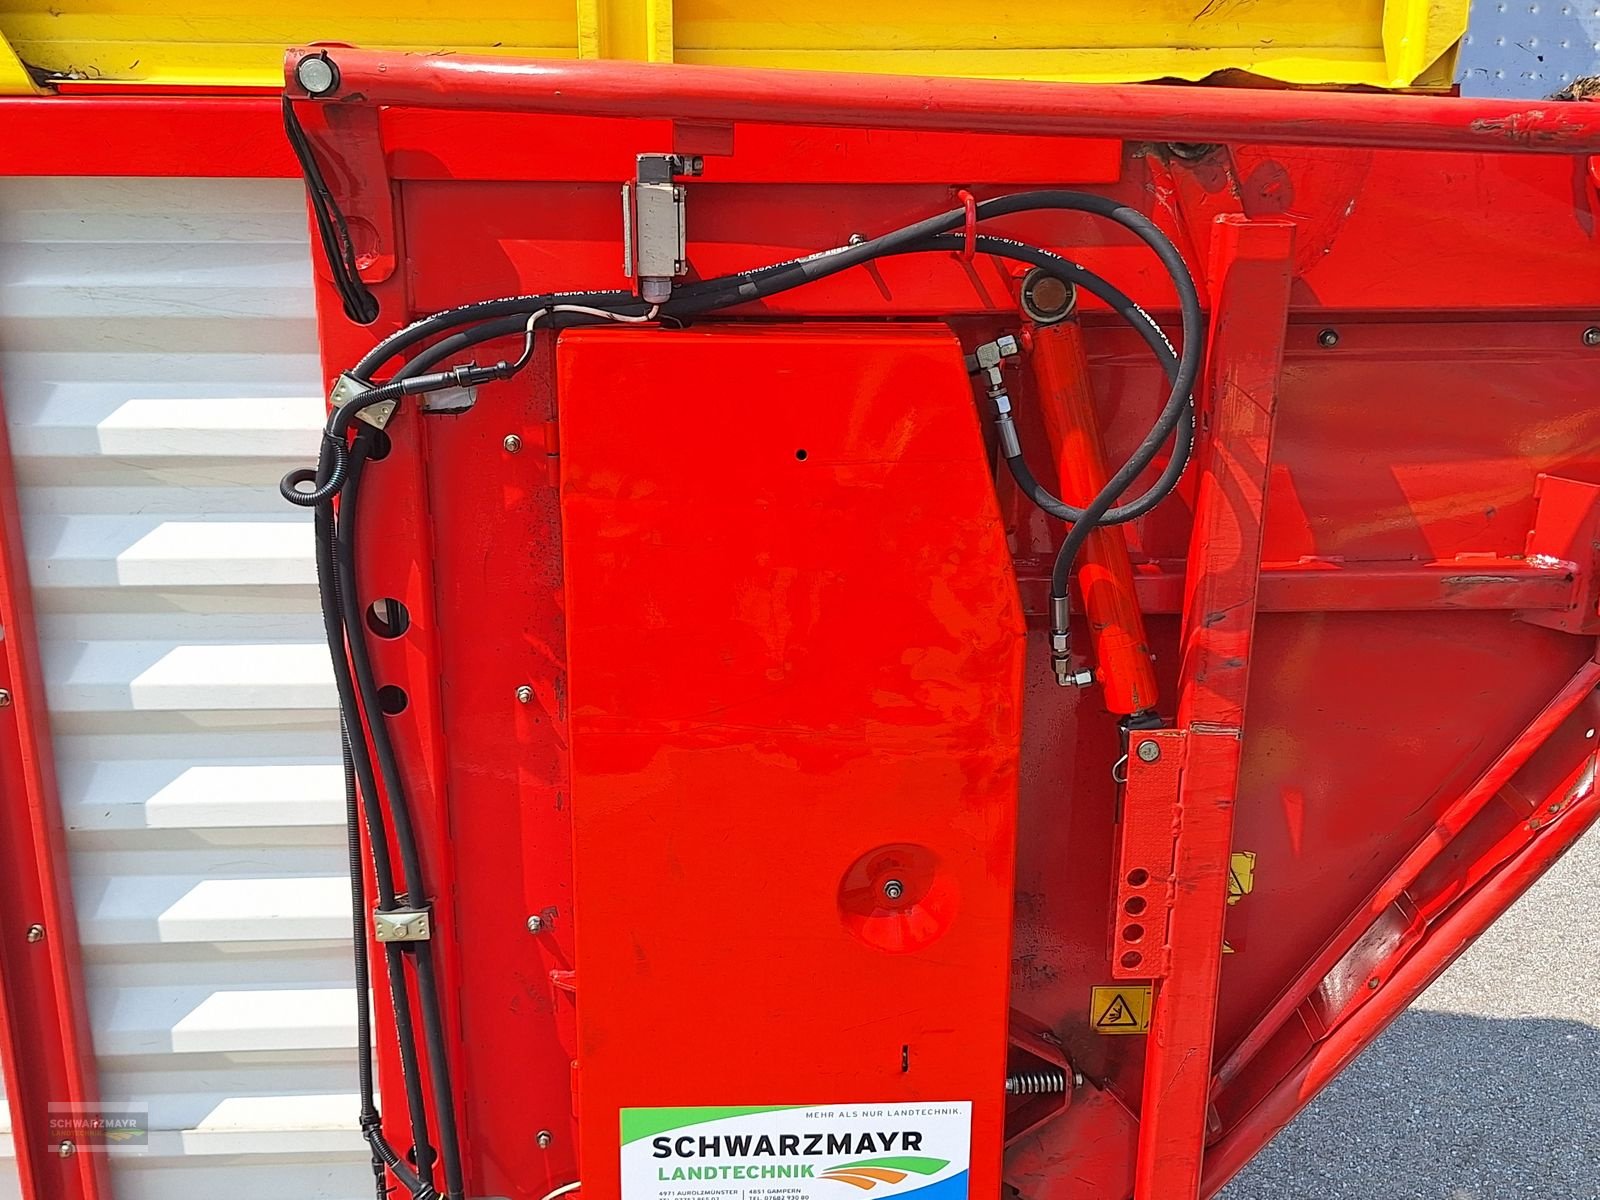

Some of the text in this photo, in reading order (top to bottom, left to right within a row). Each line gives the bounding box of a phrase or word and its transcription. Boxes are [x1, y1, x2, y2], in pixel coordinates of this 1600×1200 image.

[805, 1107, 963, 1119] MEHR ALS NUR LANDTECHNIK.
[652, 1130, 923, 1160] SCHWARZMAYR
[657, 1163, 816, 1181] LANDTECHNIK
